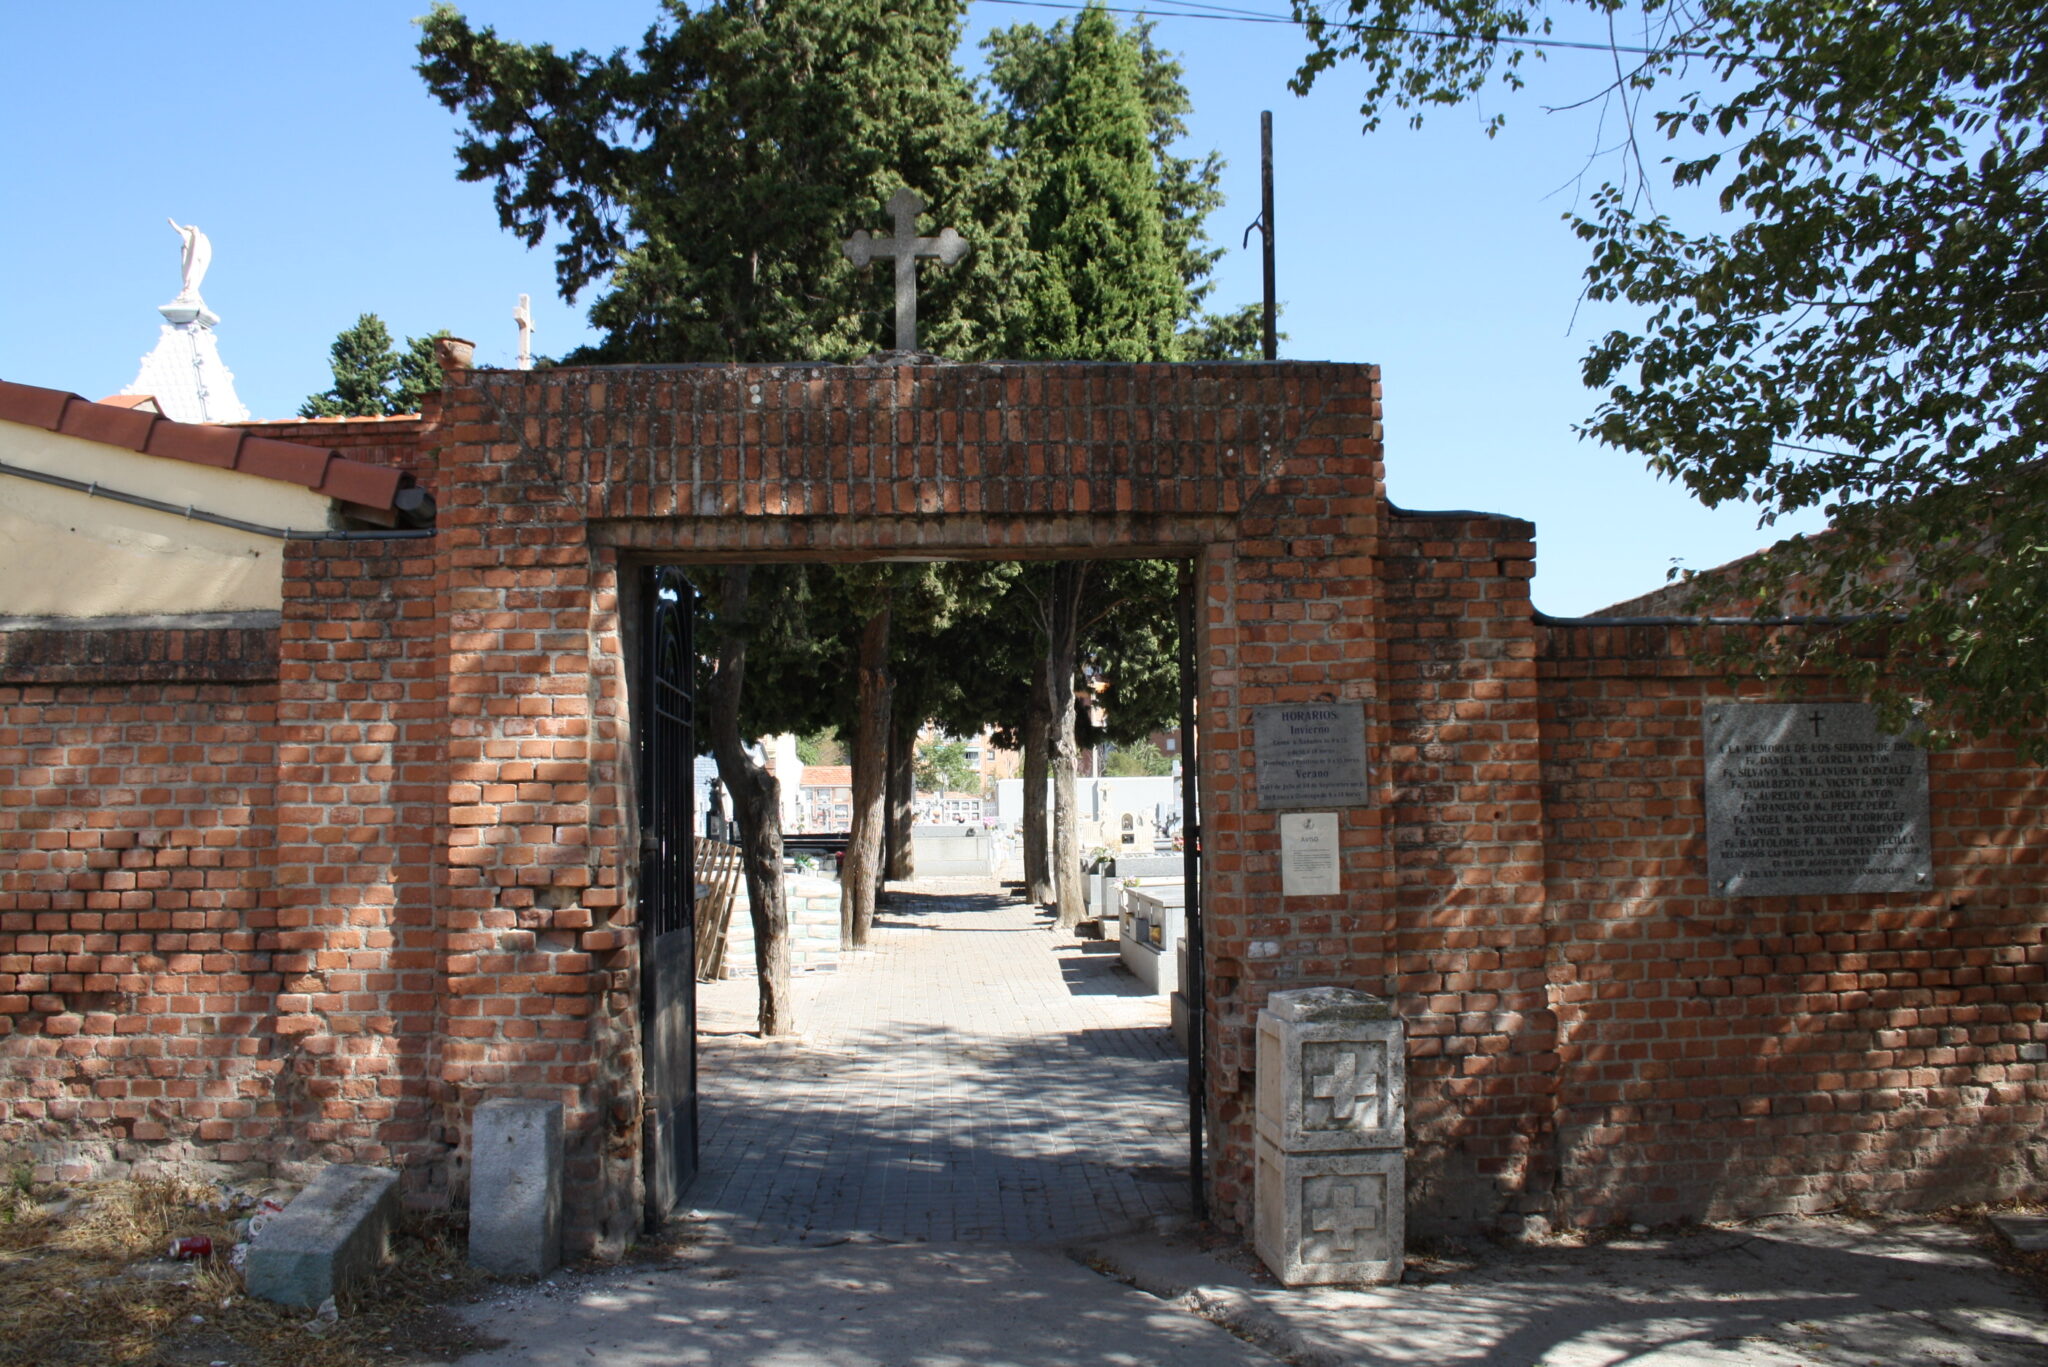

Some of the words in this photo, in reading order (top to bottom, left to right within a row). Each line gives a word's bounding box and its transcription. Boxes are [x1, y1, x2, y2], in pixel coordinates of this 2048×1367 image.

[1281, 710, 1338, 721] HORARIOS
[1290, 725, 1330, 735] Invierno
[1728, 744, 1740, 754] LA
[1744, 744, 1790, 754] MEMORIA
[1794, 743, 1808, 752] DE
[1810, 743, 1831, 752] LOS
[1834, 742, 1874, 752] SIERVOS
[1876, 742, 1889, 752] DE
[1760, 756, 1794, 765] DANIEL
[1296, 769, 1329, 778] Verano
[1738, 768, 1778, 778] SILVANO
[1799, 766, 1858, 776] VILLANUEVA
[1746, 778, 1806, 789] ADALBERTO
[1826, 778, 1868, 788] VICENTE
[1759, 790, 1800, 800] AURELIO
[1756, 802, 1810, 812] FRANCISCO
[1856, 824, 1894, 834] LOBATO
[1720, 850, 1765, 858] RELIGIOSOS
